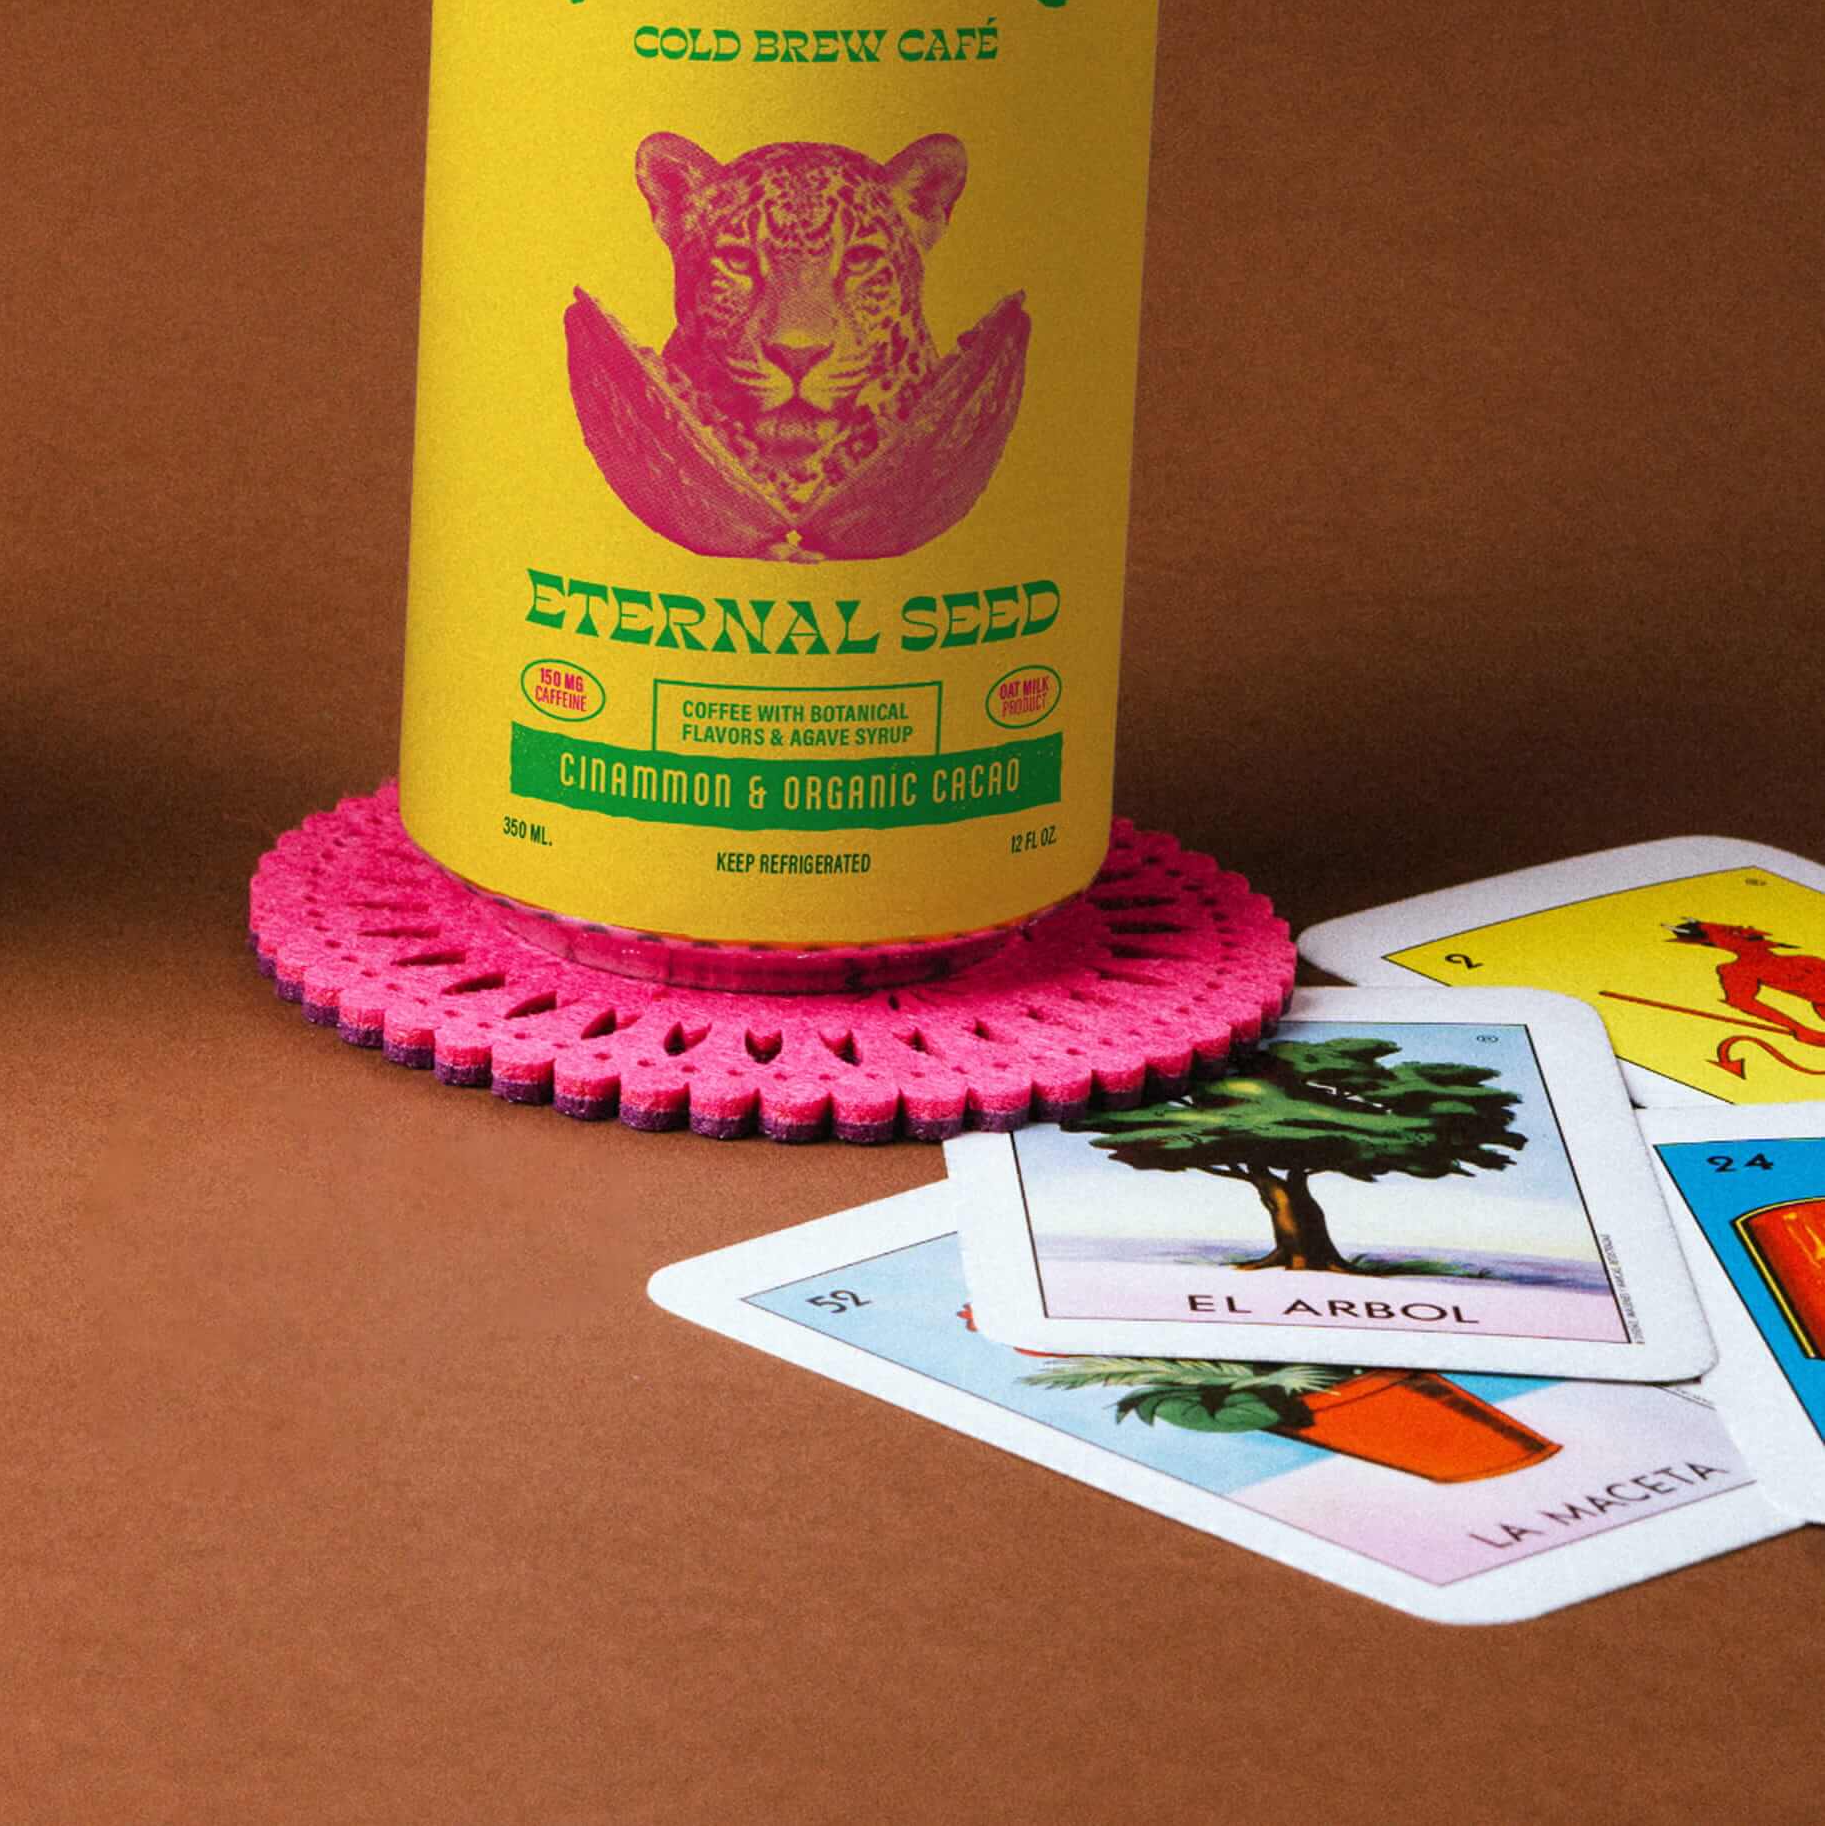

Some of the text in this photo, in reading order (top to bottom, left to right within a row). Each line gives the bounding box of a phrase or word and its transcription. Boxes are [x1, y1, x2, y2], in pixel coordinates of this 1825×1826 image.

[634, 17, 999, 63] COLD BREW CAFÉ
[525, 568, 1061, 654] ETERNAL SEED
[540, 667, 584, 693] 150 MG
[999, 675, 1050, 701] OAT MILK
[534, 685, 588, 712] CAFFEINE
[682, 700, 909, 723] COFFEE WITH BOTANICAL
[1001, 692, 1048, 718] PRODUCT
[682, 723, 914, 747] FLAVORS & AGAVE SYRUP
[559, 751, 1020, 811] CINAMMON & ORGANIC CACAO
[502, 815, 553, 847] 350 ML.
[1011, 834, 1023, 854] 12
[1025, 830, 1038, 850] FL
[716, 851, 871, 874] KEEP REFRIGERATED
[1444, 952, 1484, 971] 2
[1706, 1152, 1774, 1173] 24
[806, 1289, 872, 1314] 52
[1187, 1294, 1480, 1325] EL ARBOL
[1468, 1461, 1730, 1549] LA MACETA
